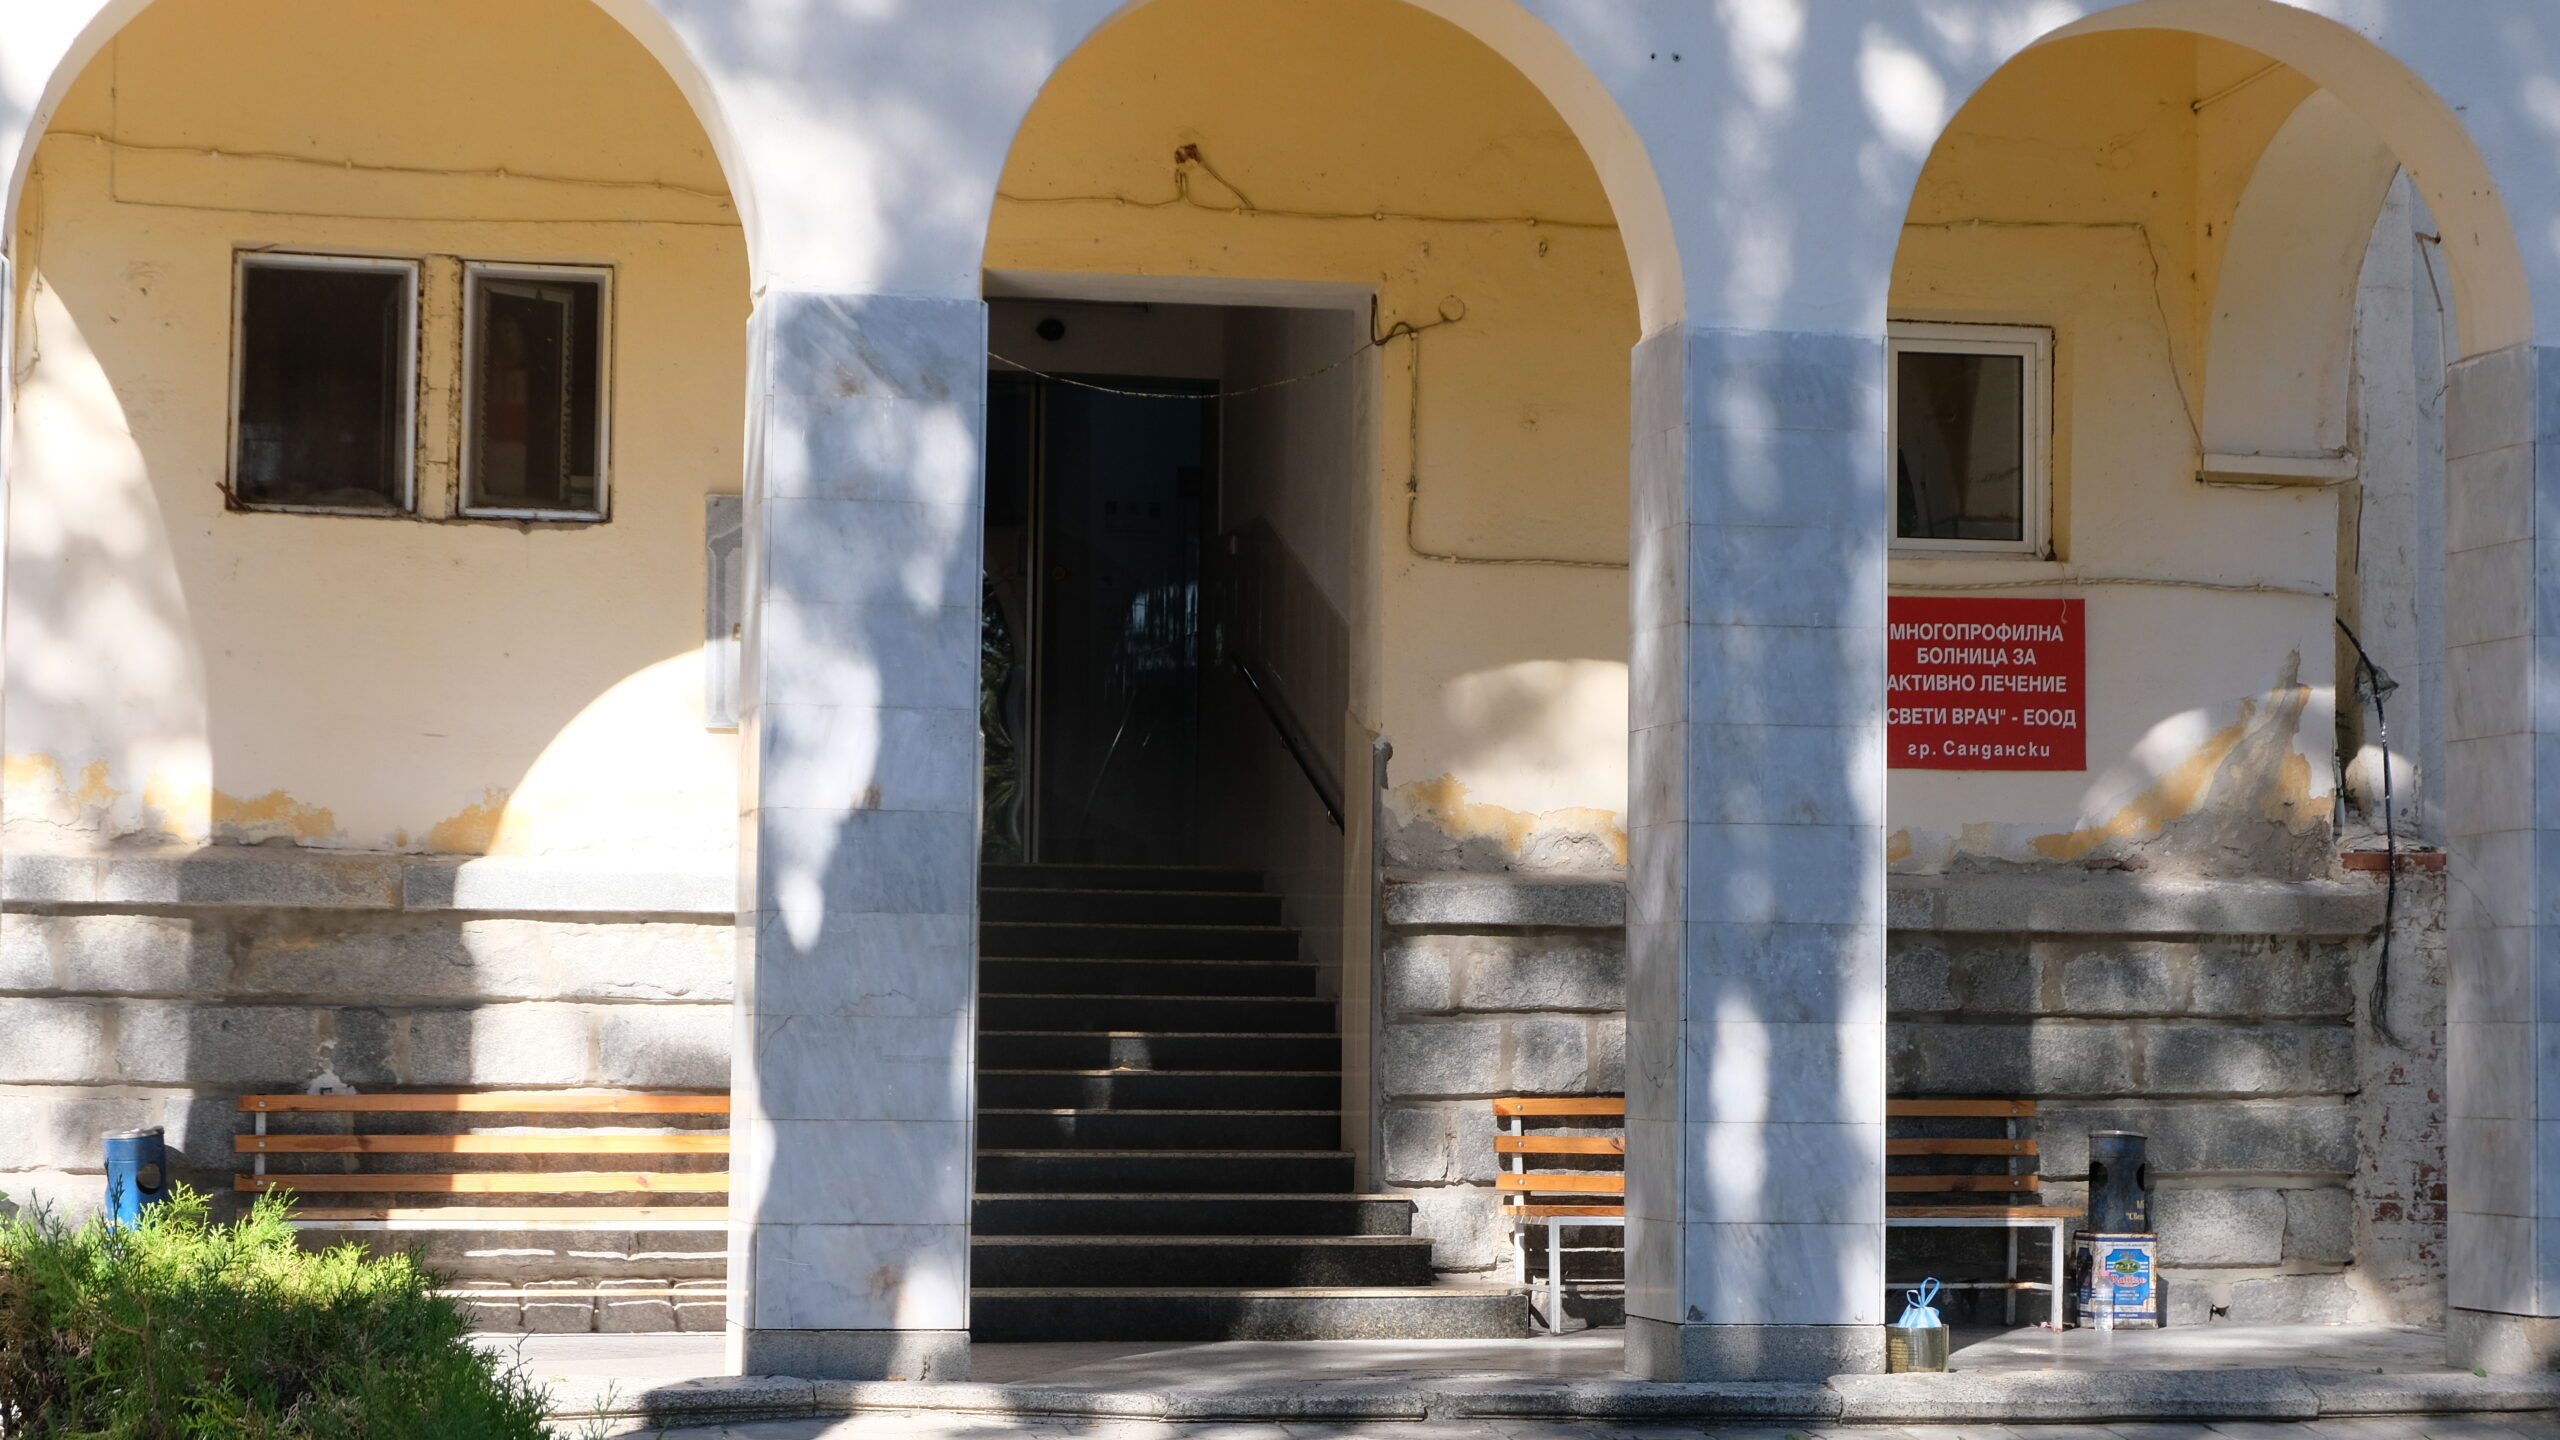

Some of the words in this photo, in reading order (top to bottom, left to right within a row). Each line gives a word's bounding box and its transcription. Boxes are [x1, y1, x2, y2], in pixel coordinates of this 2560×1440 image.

[1890, 623, 2064, 642] МНОГОПРОФИЛНА
[1917, 647, 2008, 667] БОЛНИЦА
[2013, 648, 2037, 665] ЗА
[1887, 674, 1976, 691] АКТИВНО
[1980, 675, 2067, 693] ЛЕЧЕНИЕ
[1887, 707, 1947, 725] СВЕТИ
[1952, 708, 2006, 725] ВРАЧ"
[2023, 709, 2077, 729] ЕООД
[1907, 743, 1937, 759] гр.
[1943, 740, 2050, 760] Сандански
